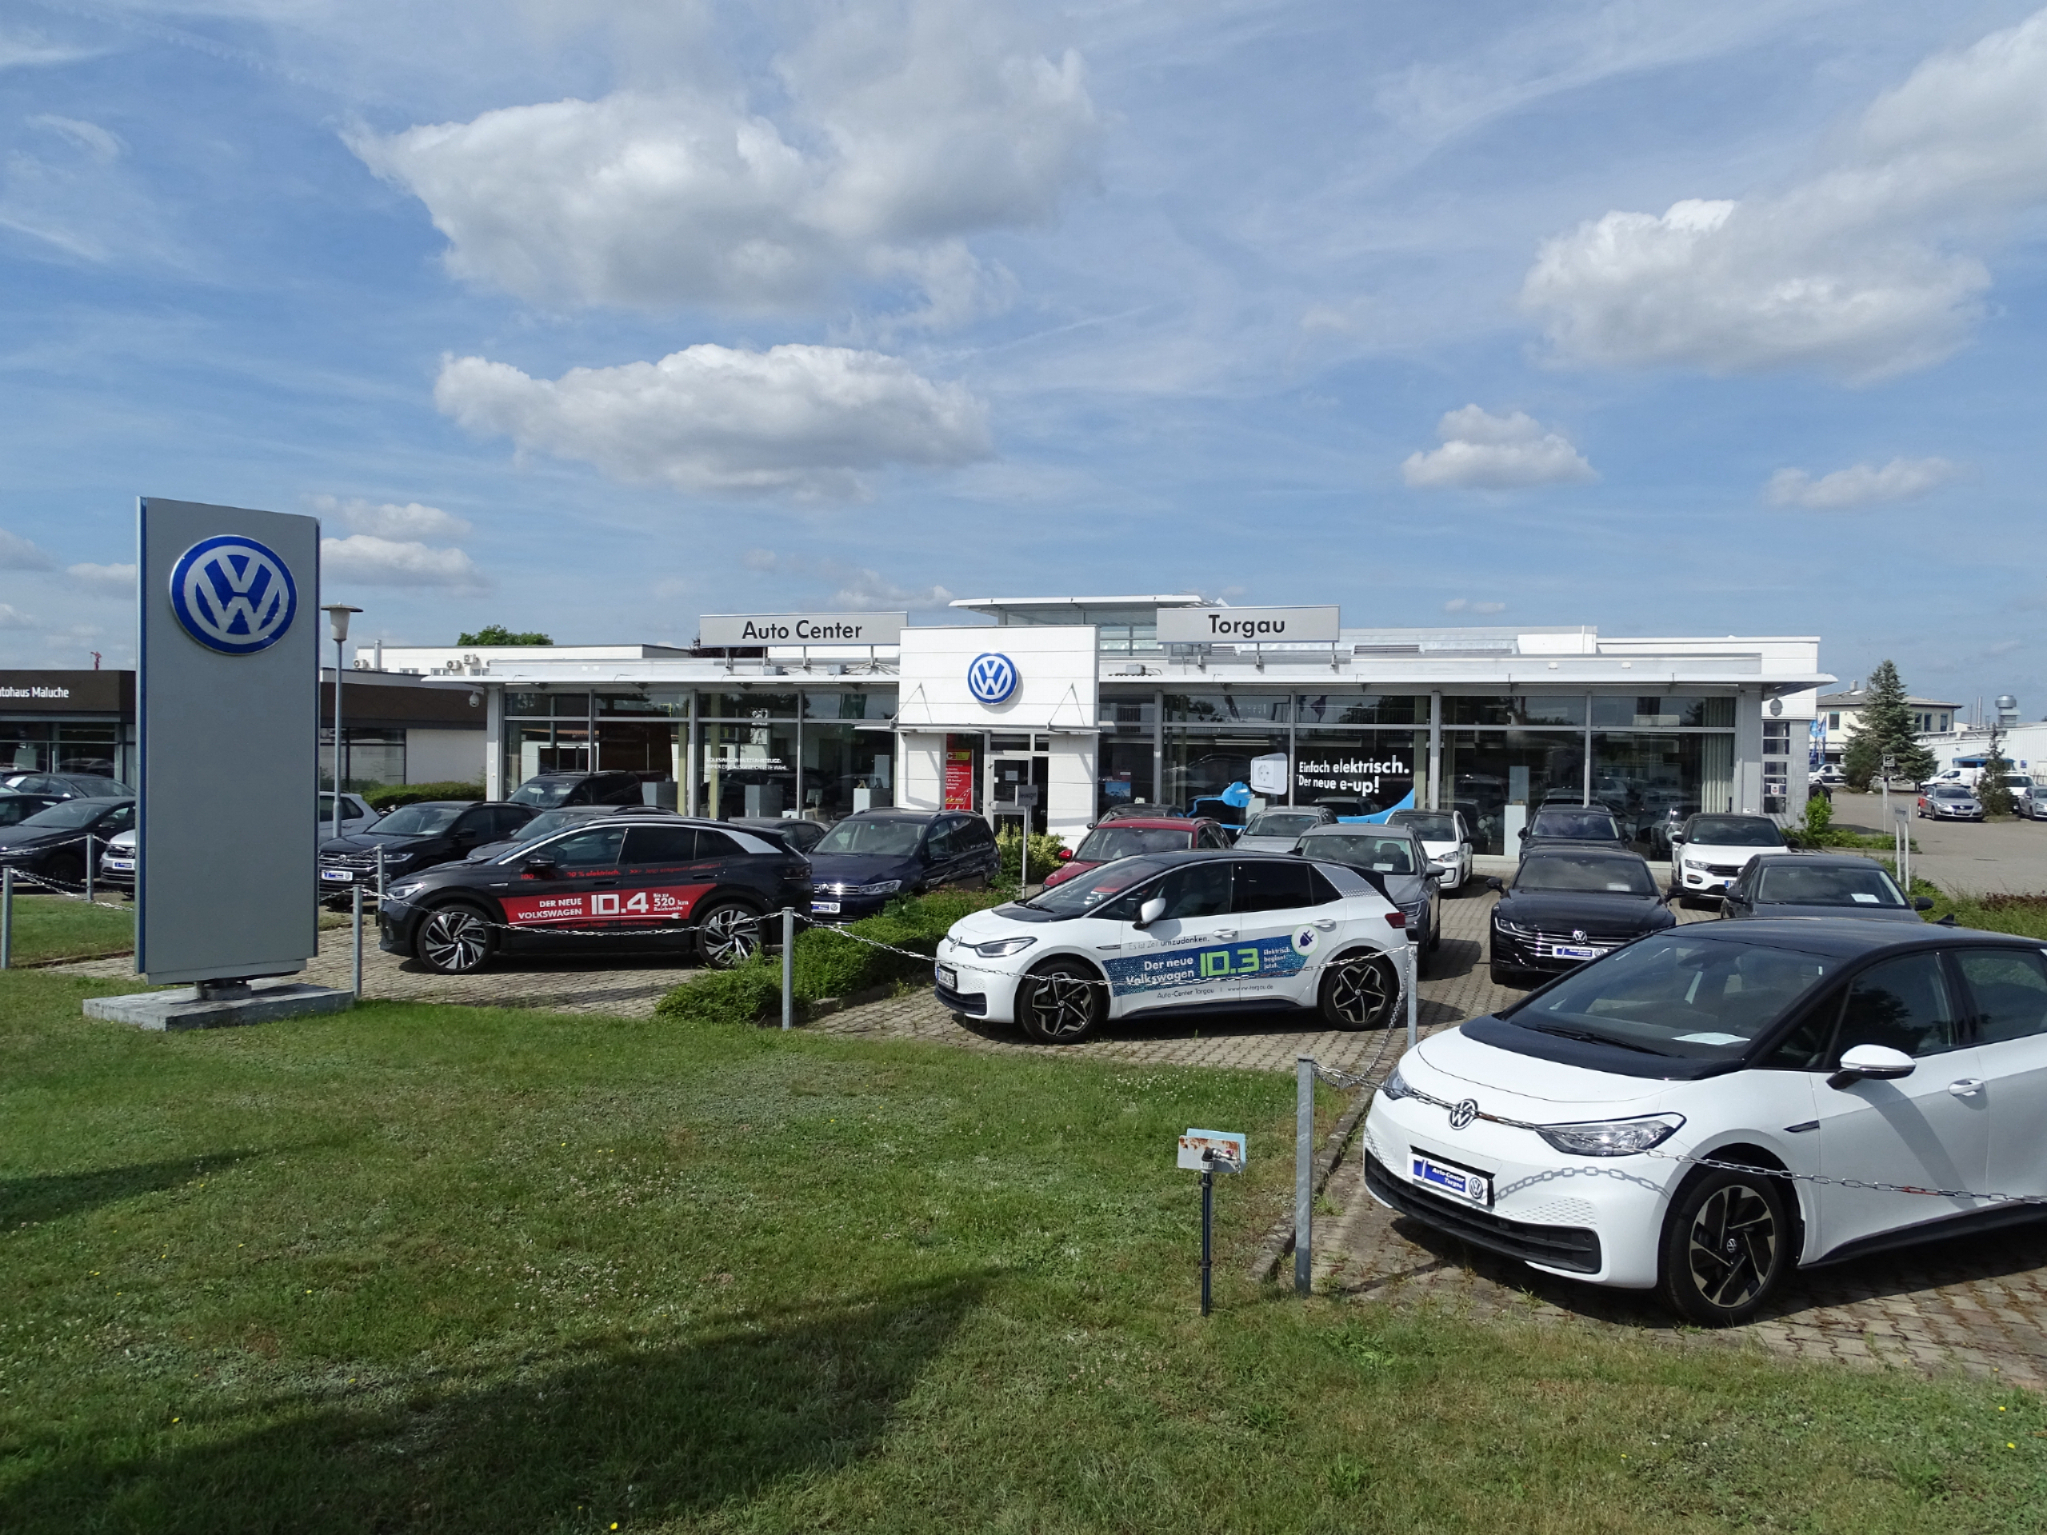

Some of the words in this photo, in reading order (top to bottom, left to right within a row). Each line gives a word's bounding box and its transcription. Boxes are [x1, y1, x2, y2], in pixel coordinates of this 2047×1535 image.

[742, 621, 789, 639] Auto
[796, 620, 862, 638] Center
[1208, 615, 1285, 638] Torgau
[32, 687, 69, 698] Maluche
[1299, 760, 1330, 773] Einfach
[1332, 755, 1410, 774] elektrisch.
[1298, 775, 1312, 787] Der
[1313, 778, 1336, 789] neue
[1339, 776, 1380, 797] e-up!
[539, 900, 557, 908] DER
[558, 898, 582, 907] NEUE
[653, 897, 676, 907] 520
[518, 908, 582, 919] VOLKSWAGEN
[1144, 961, 1164, 971] Der
[1166, 957, 1194, 968] neue
